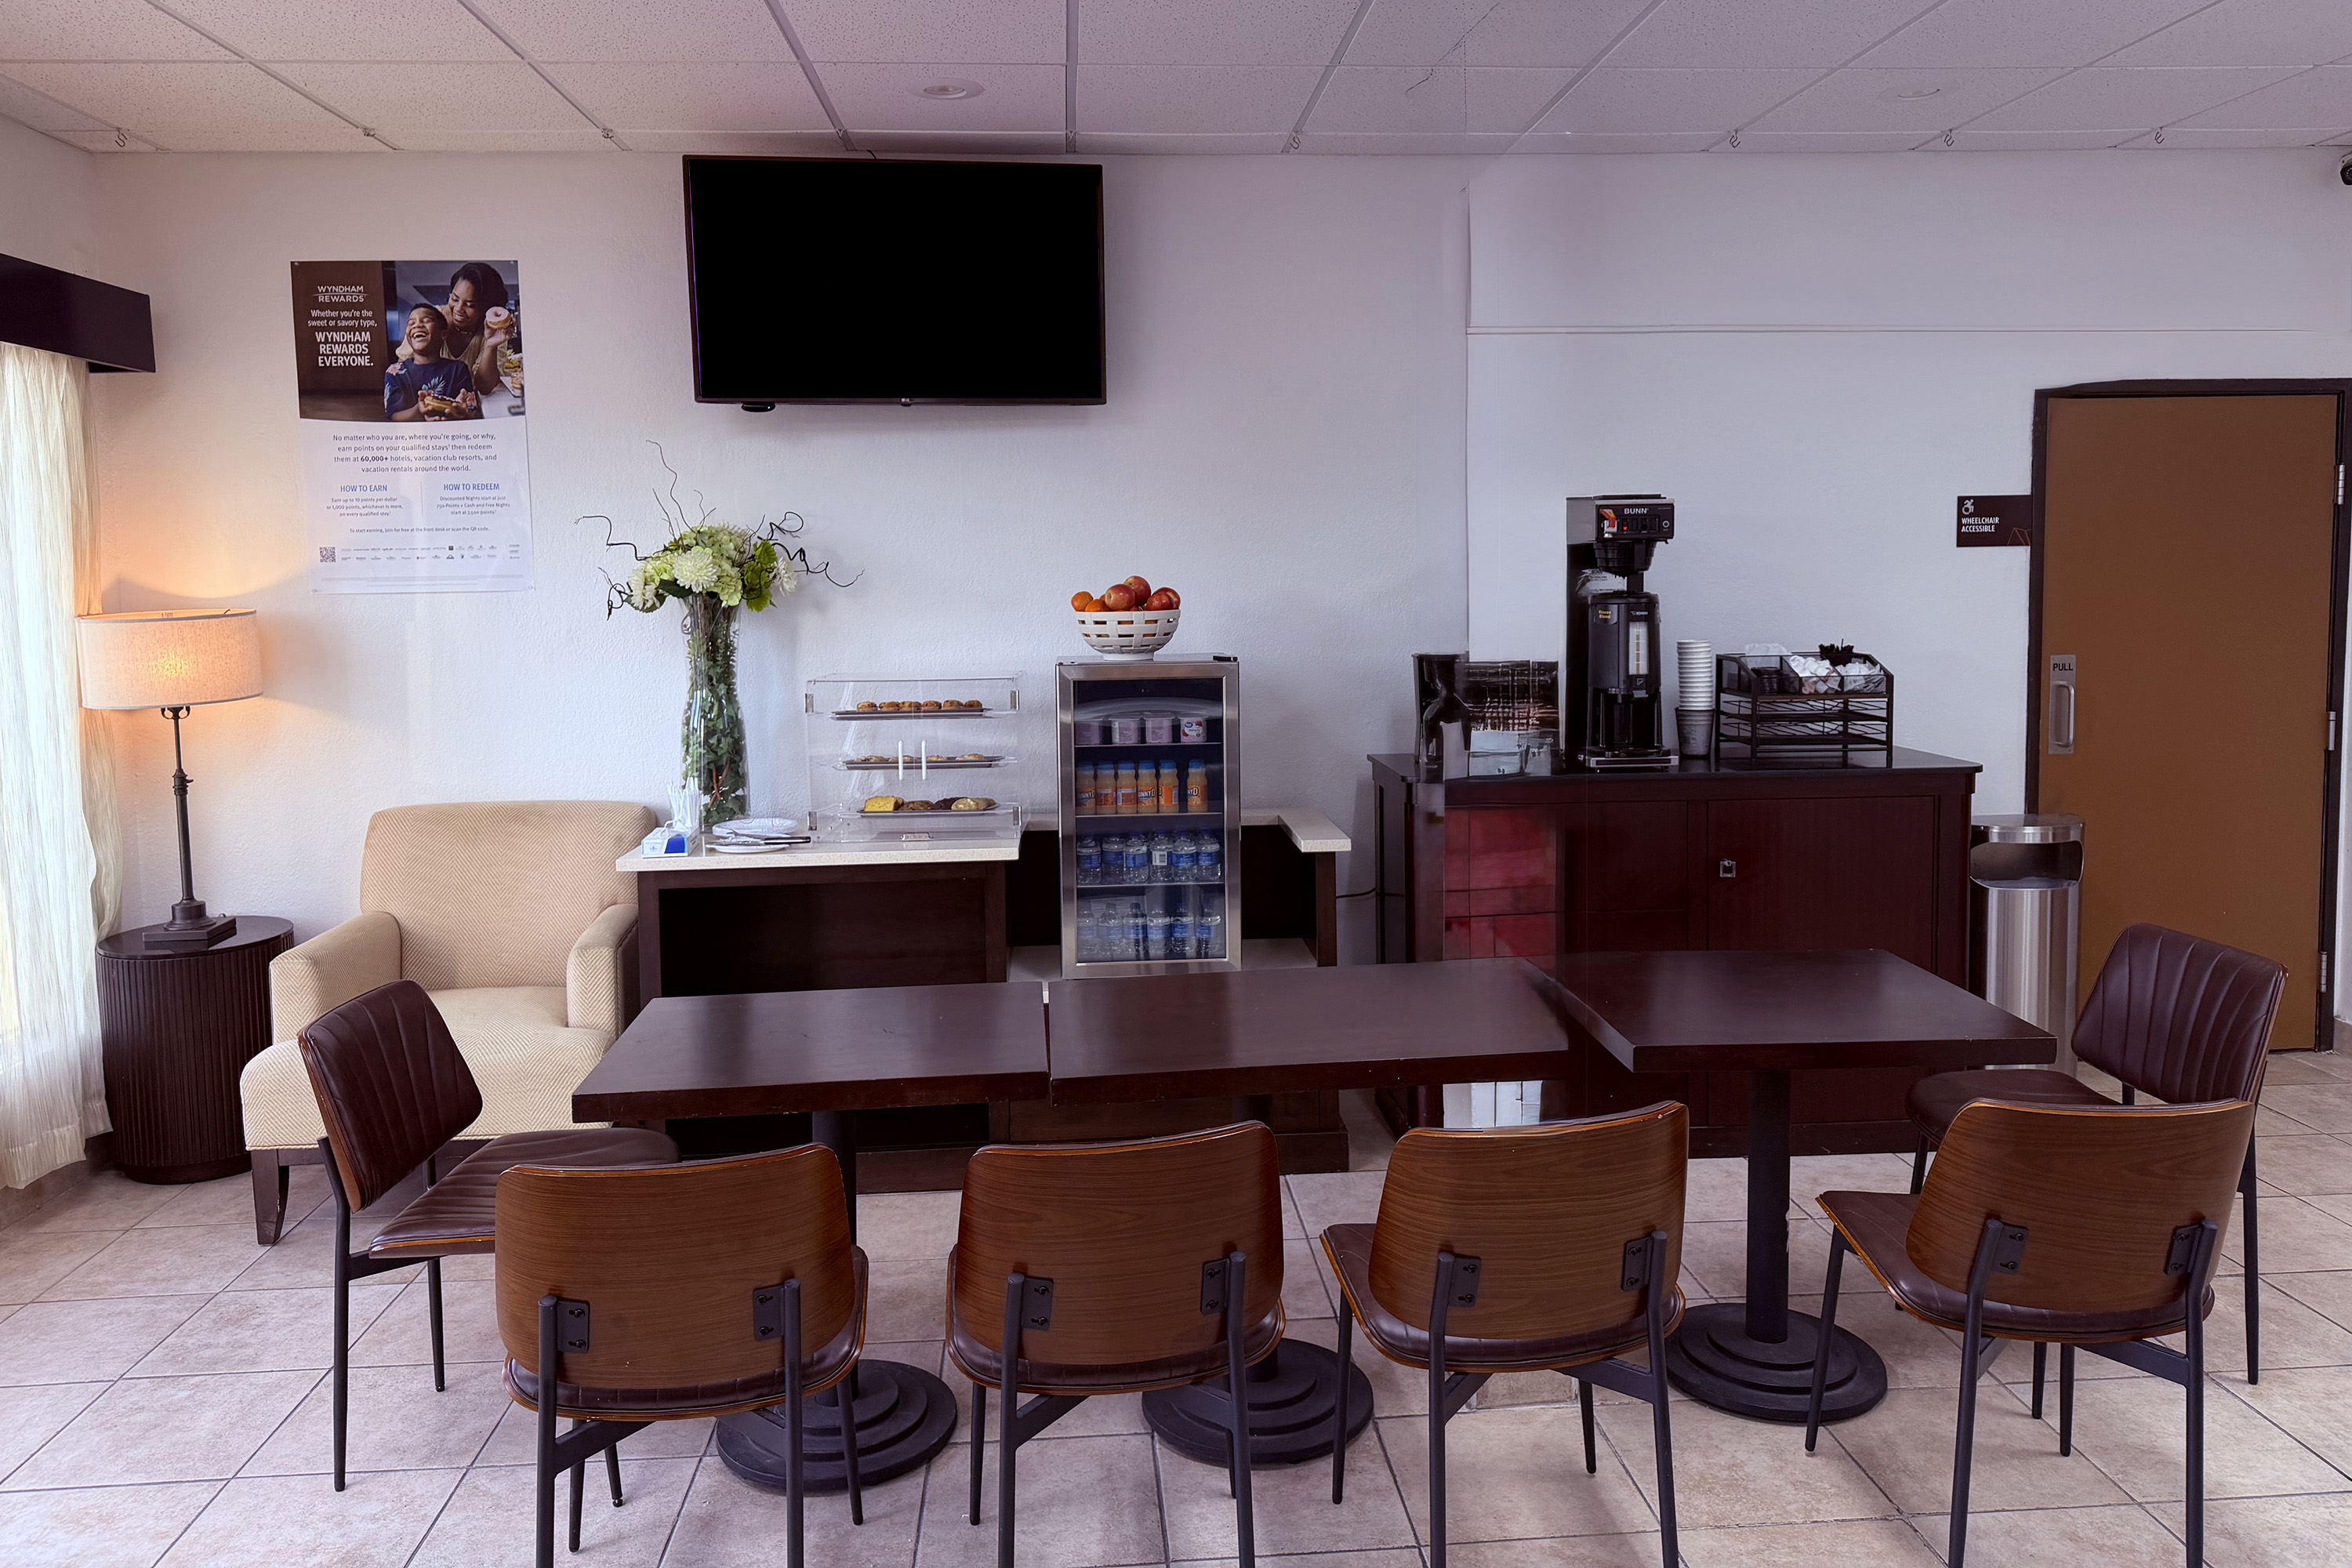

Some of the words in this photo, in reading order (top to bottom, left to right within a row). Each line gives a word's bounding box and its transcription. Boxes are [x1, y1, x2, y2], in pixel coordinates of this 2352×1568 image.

[339, 310, 361, 318] you're
[360, 319, 377, 328] type,
[315, 331, 371, 342] WYNDHAM
[319, 343, 368, 354] REWARDS
[318, 355, 374, 367] EVERYONE.
[2053, 662, 2074, 671] PULL
